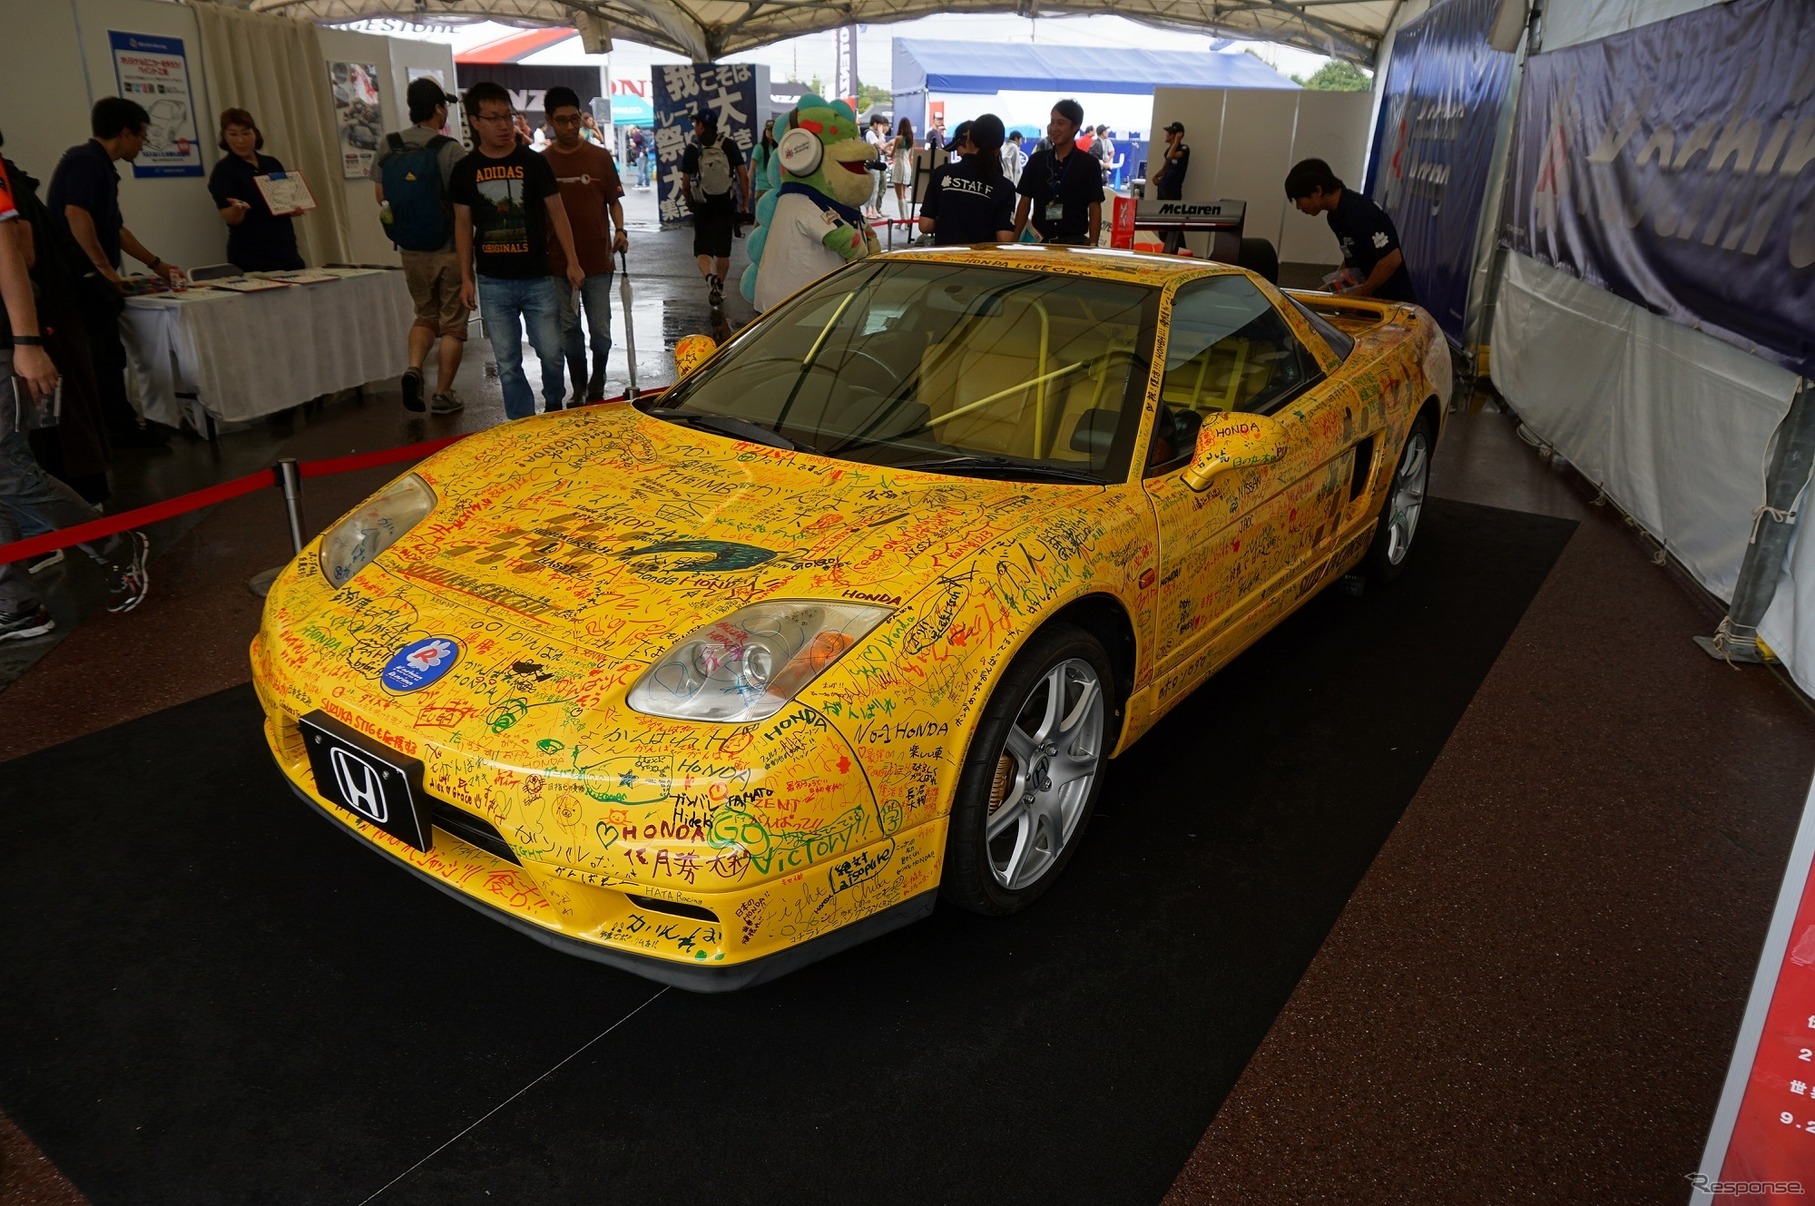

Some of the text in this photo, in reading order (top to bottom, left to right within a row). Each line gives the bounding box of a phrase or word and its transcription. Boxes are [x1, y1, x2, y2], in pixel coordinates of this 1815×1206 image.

[476, 166, 524, 182] ADIDAS
[1159, 203, 1221, 216] McLaren
[482, 243, 528, 254] ORIGINALS
[1216, 422, 1260, 438] HONDA
[841, 589, 902, 606] HONDA
[320, 697, 353, 725] SUZUKA
[763, 708, 827, 741] HONDA
[622, 820, 706, 844] HONDA
[645, 886, 674, 900] HATA
[676, 891, 704, 906] Racing
